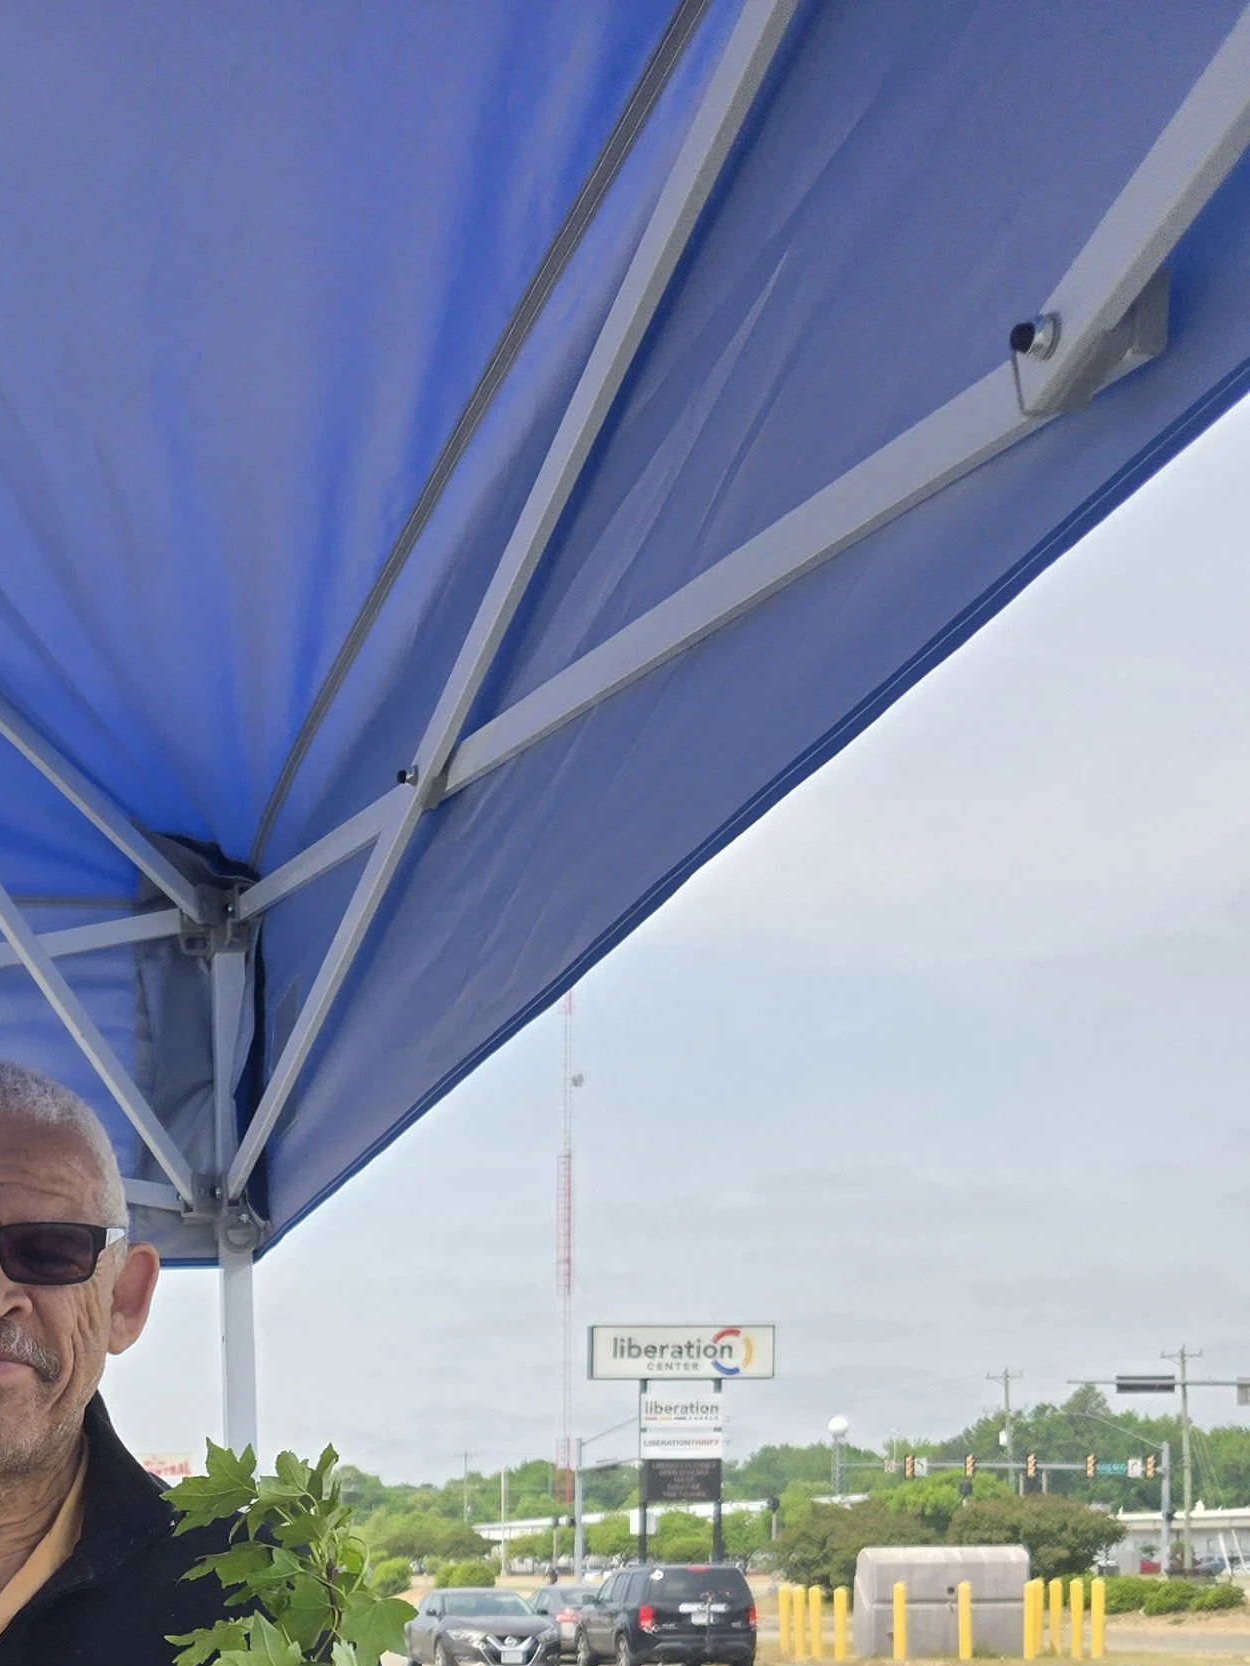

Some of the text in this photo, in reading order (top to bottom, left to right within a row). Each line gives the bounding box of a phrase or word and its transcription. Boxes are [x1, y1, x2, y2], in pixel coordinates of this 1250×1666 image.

[612, 1337, 733, 1359] liberation
[647, 1362, 700, 1371] CENTER
[645, 1400, 719, 1415] liberation
